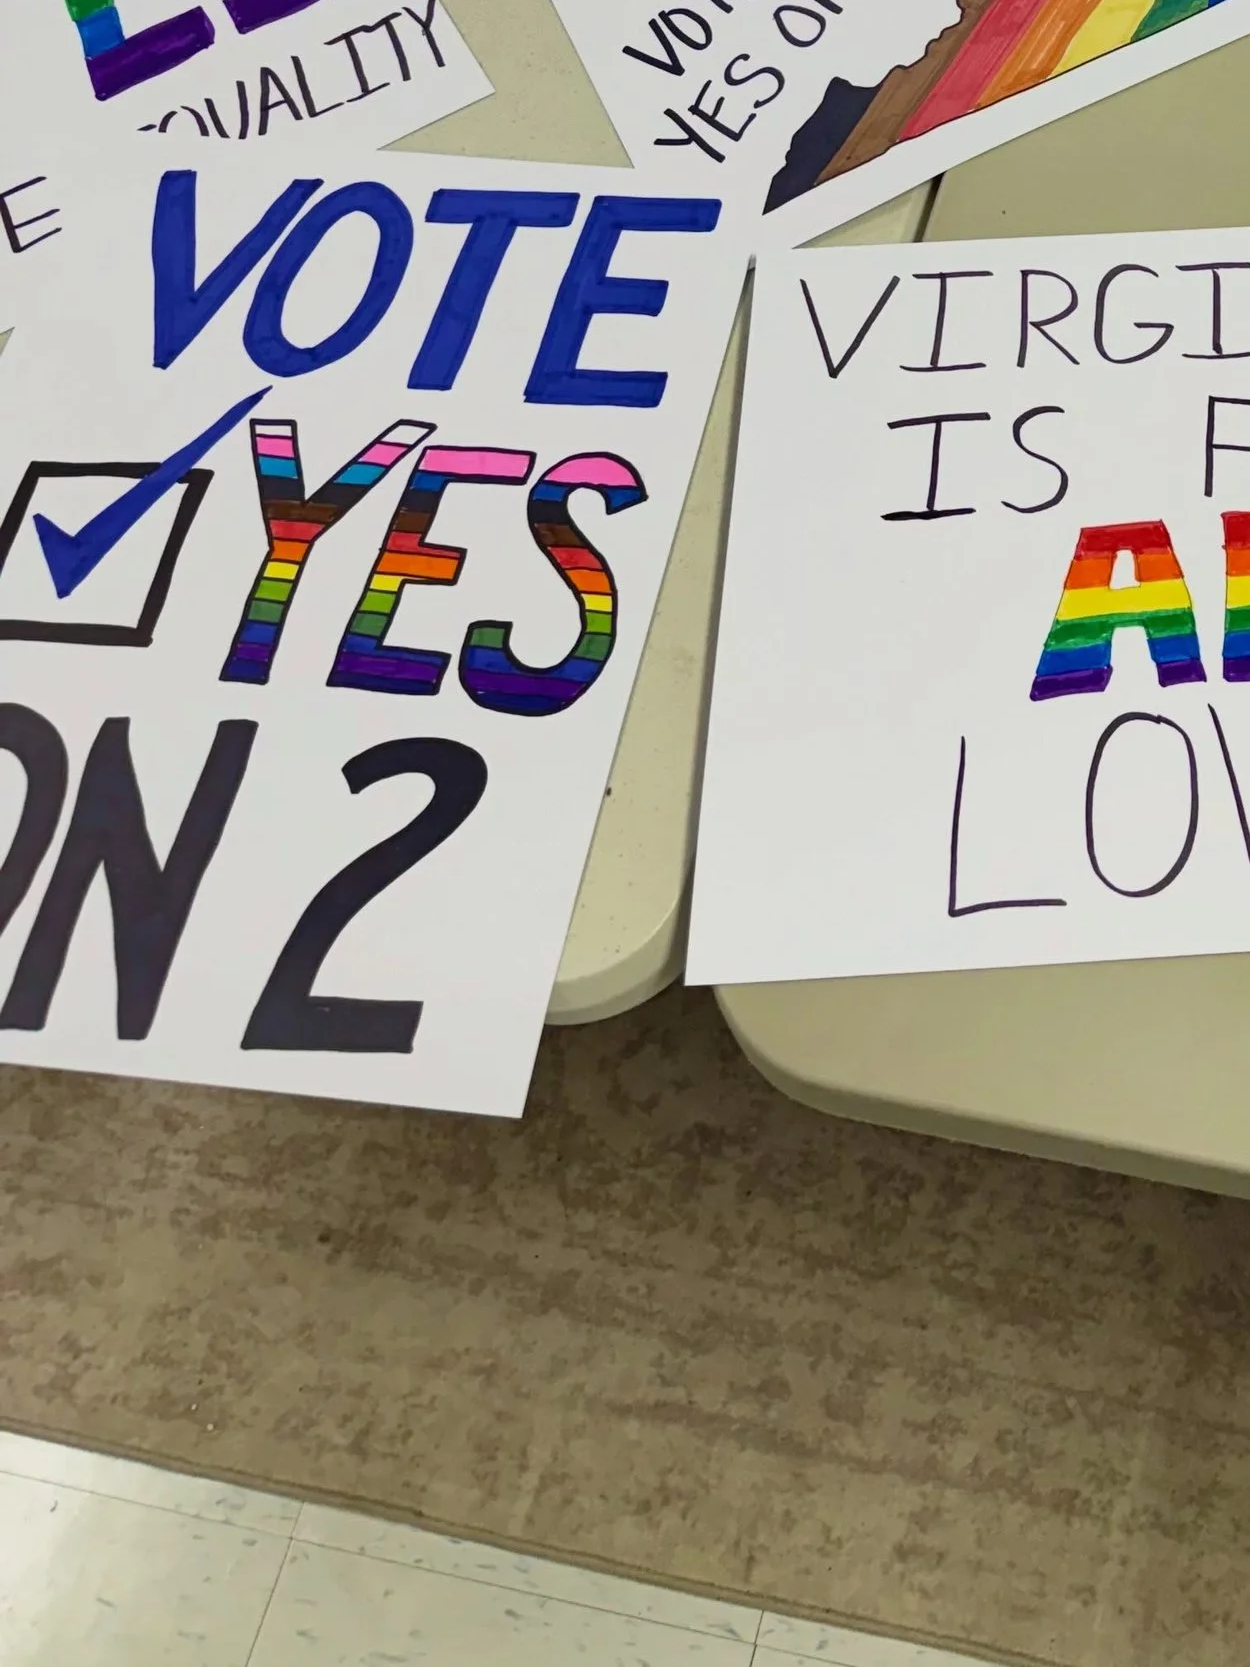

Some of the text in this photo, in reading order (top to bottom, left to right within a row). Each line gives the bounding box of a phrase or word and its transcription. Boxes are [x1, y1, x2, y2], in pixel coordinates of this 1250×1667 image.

[653, 52, 786, 164] YES
[151, 170, 722, 409] VOTE
[219, 418, 649, 716] YES
[881, 405, 1069, 521] IS
[240, 735, 489, 1054] 2
